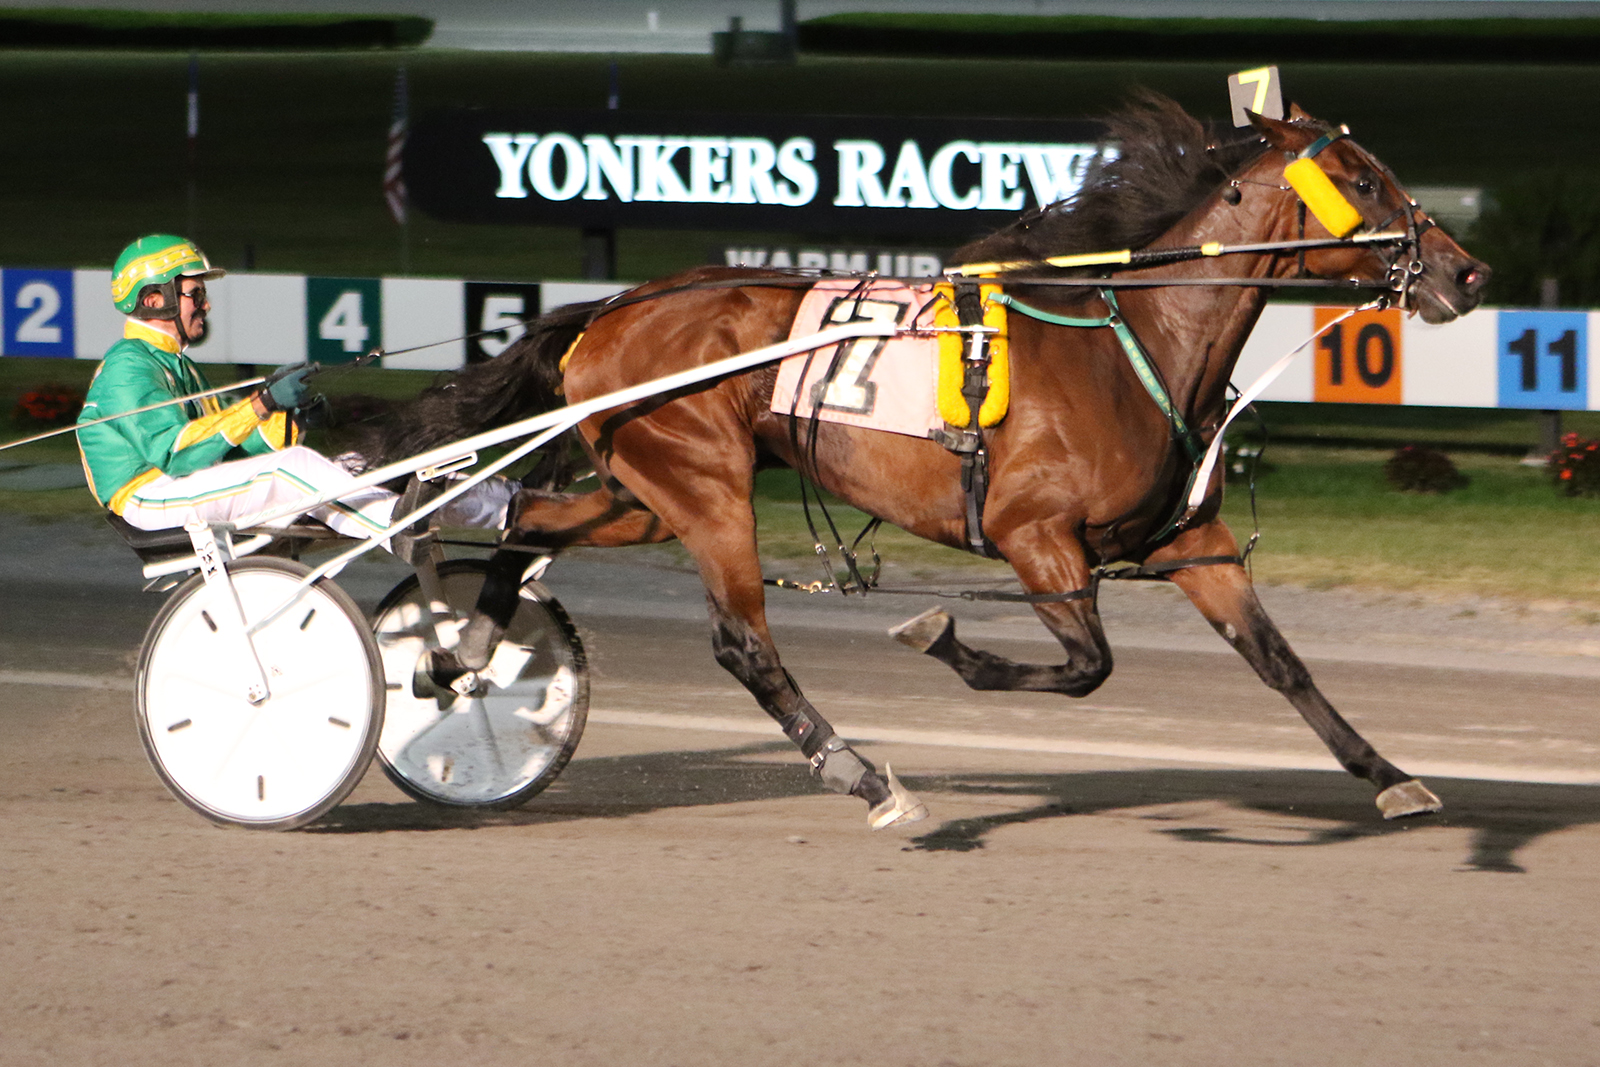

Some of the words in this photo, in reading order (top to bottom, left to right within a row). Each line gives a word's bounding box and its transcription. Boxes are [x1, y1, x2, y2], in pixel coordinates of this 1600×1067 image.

[1238, 66, 1271, 114] 7
[484, 133, 818, 207] YONKERS
[832, 140, 1121, 211] RACEW
[15, 281, 62, 343] 2
[319, 291, 370, 352] 4
[479, 295, 528, 358] 5
[1319, 322, 1394, 388] 10
[1508, 328, 1578, 392] 11
